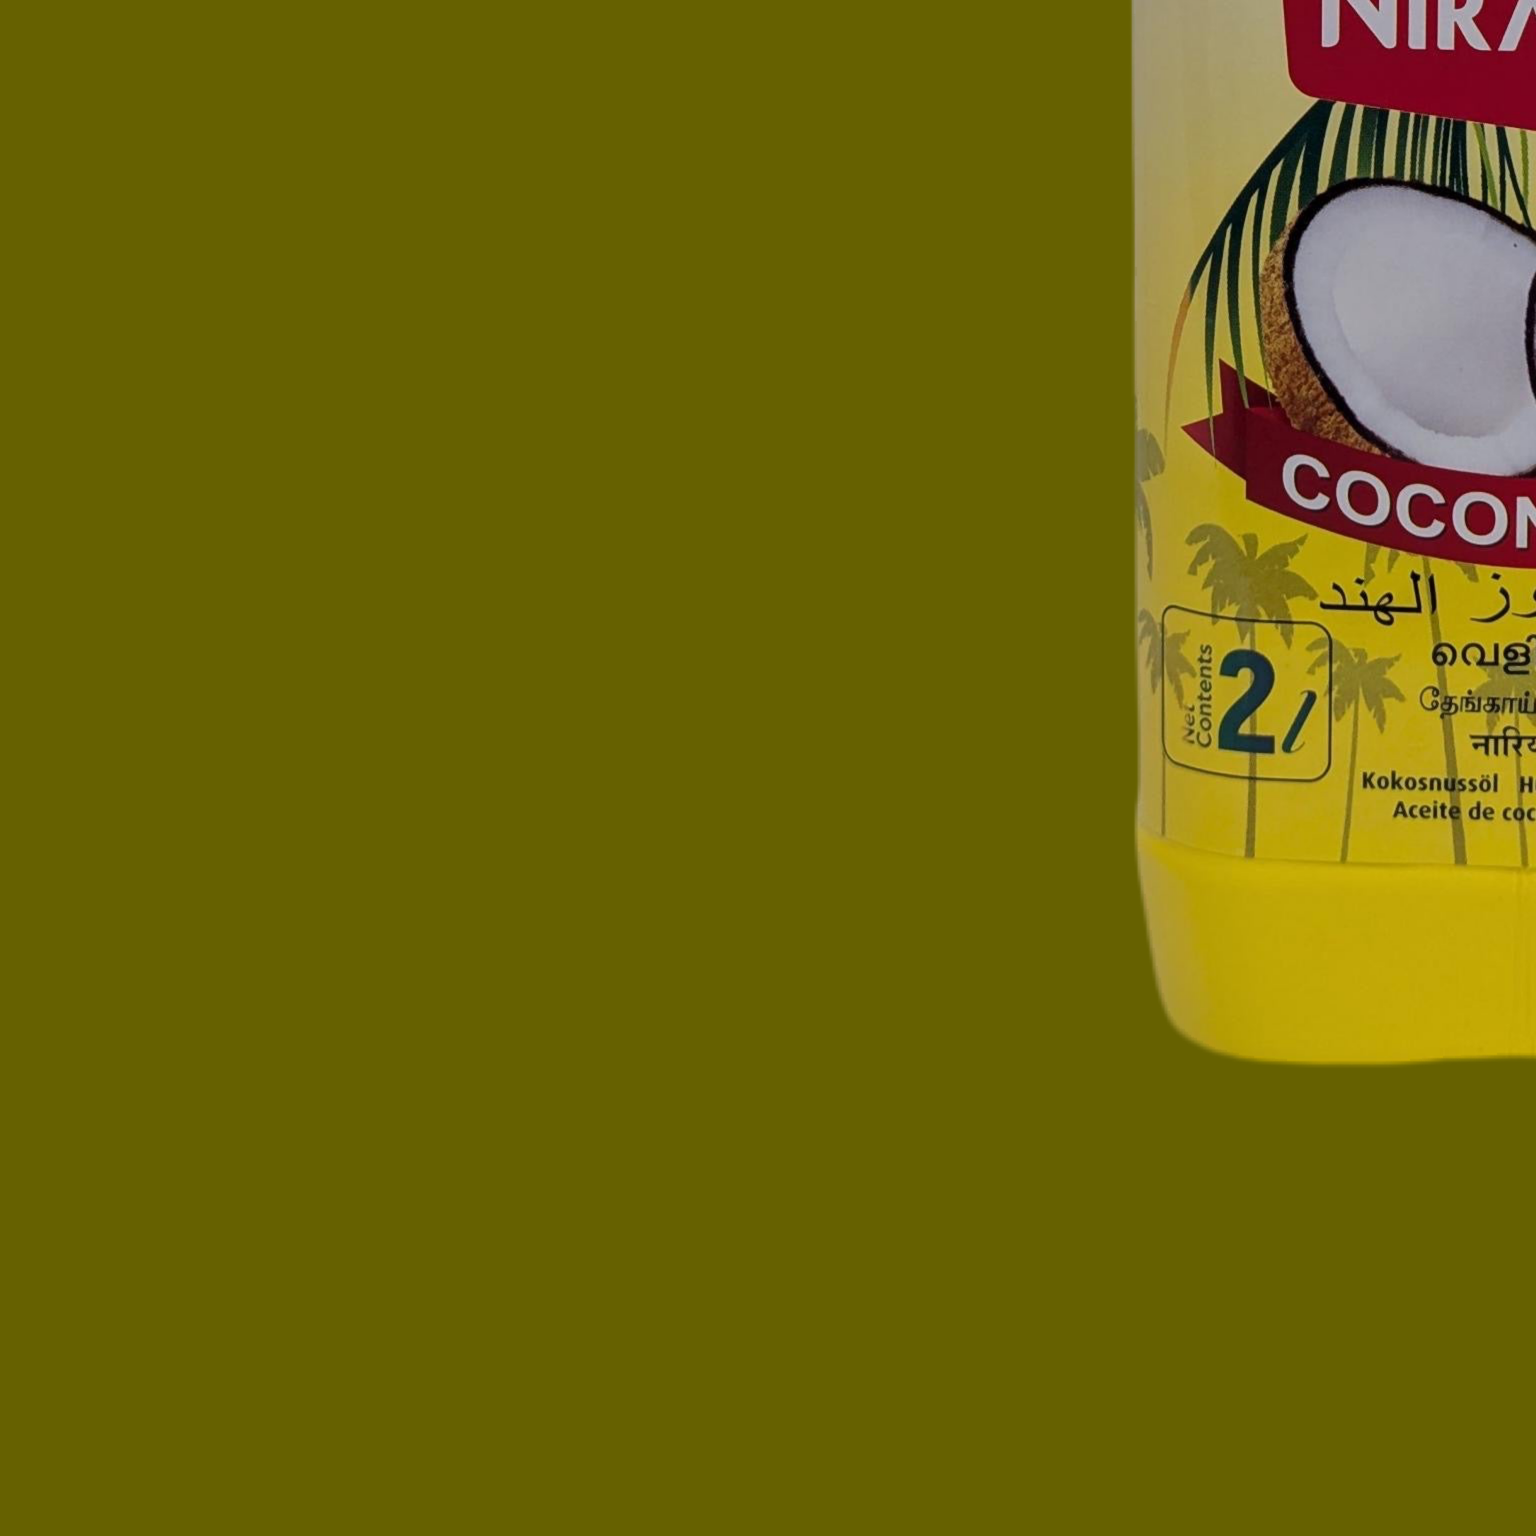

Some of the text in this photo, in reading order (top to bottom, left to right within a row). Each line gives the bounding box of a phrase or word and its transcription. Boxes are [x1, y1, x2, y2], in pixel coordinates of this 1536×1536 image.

[1319, 571, 1438, 626] الهند
[1196, 644, 1212, 748] Contents
[1361, 771, 1499, 794] Kokosnussöl
[1393, 801, 1461, 821] Aceite
[1468, 802, 1495, 822] de
